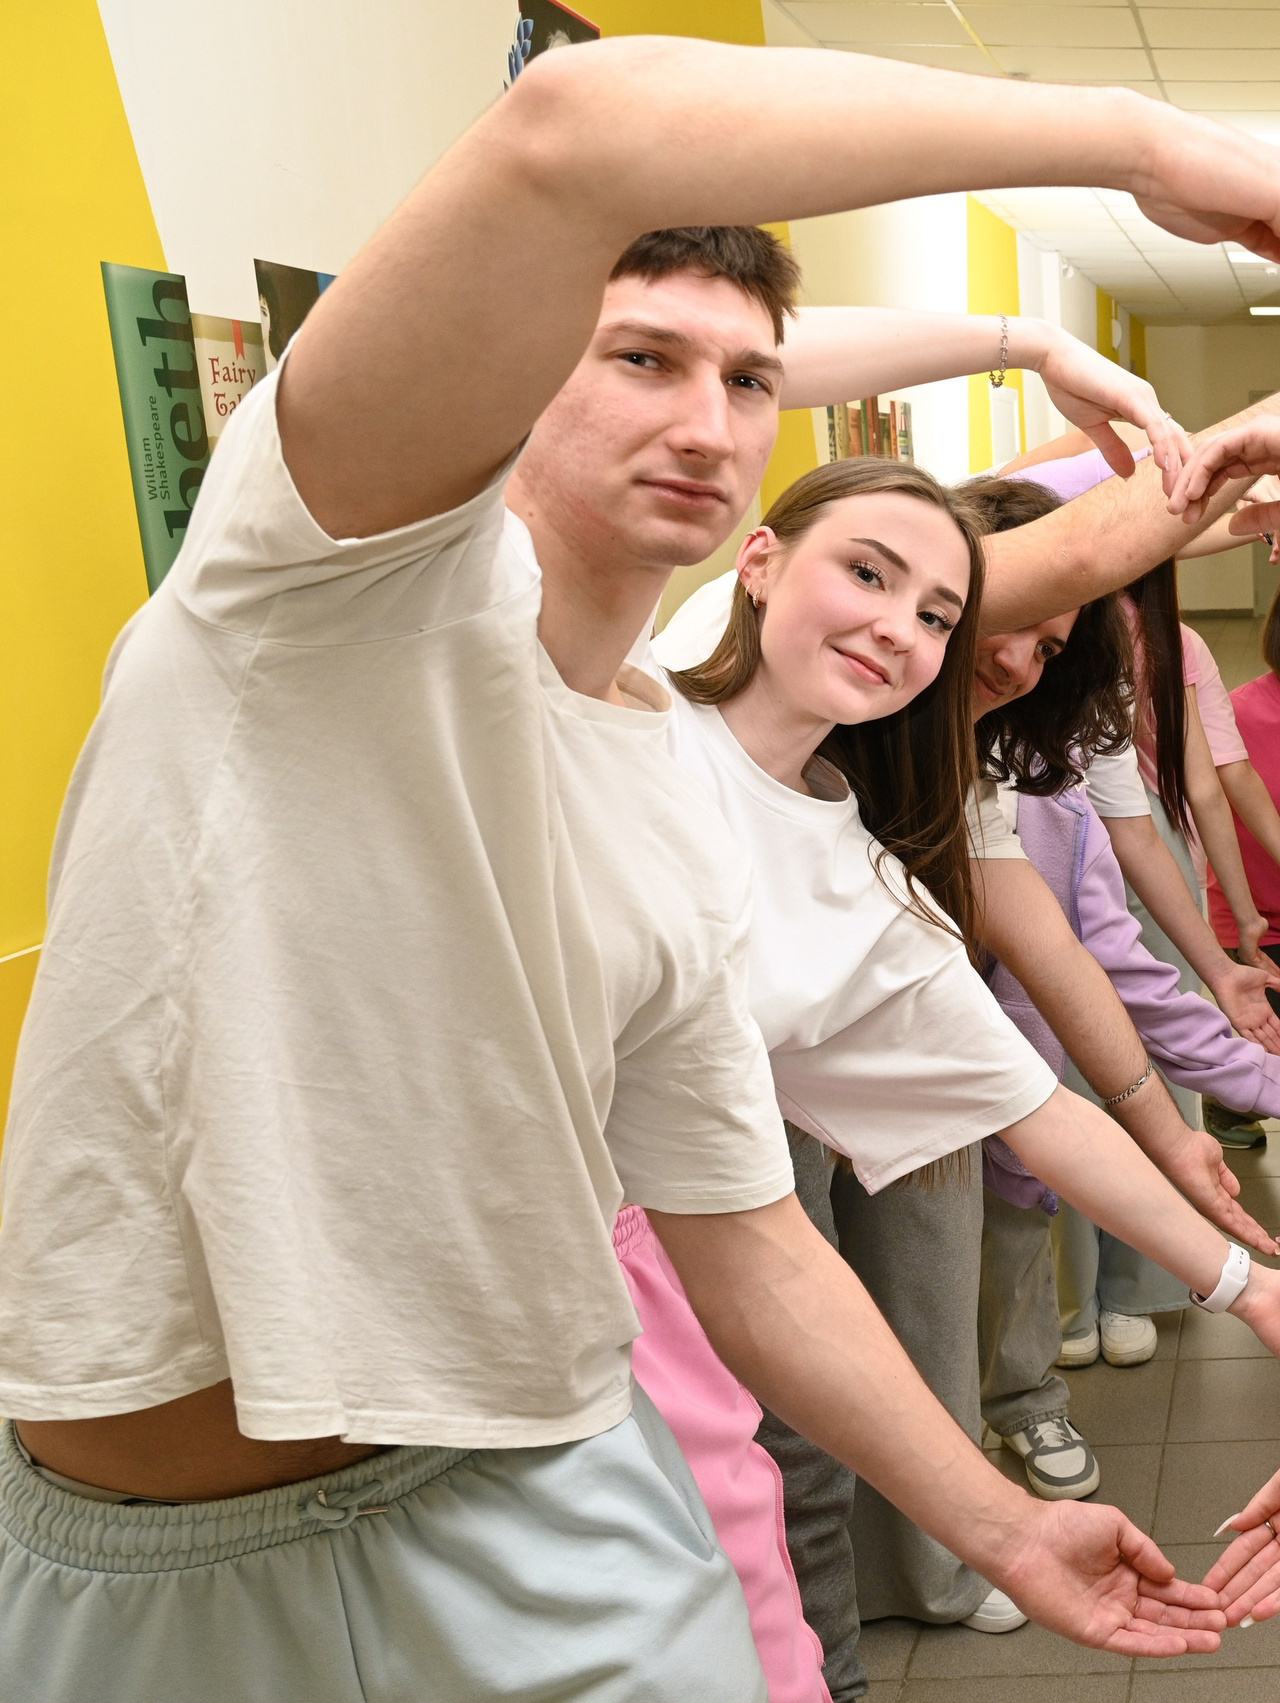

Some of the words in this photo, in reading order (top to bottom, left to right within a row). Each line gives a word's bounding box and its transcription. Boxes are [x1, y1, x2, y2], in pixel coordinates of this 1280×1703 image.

[208, 357, 256, 388] Fairy
[143, 438, 158, 500] William
[149, 396, 170, 500] Shakespeare
